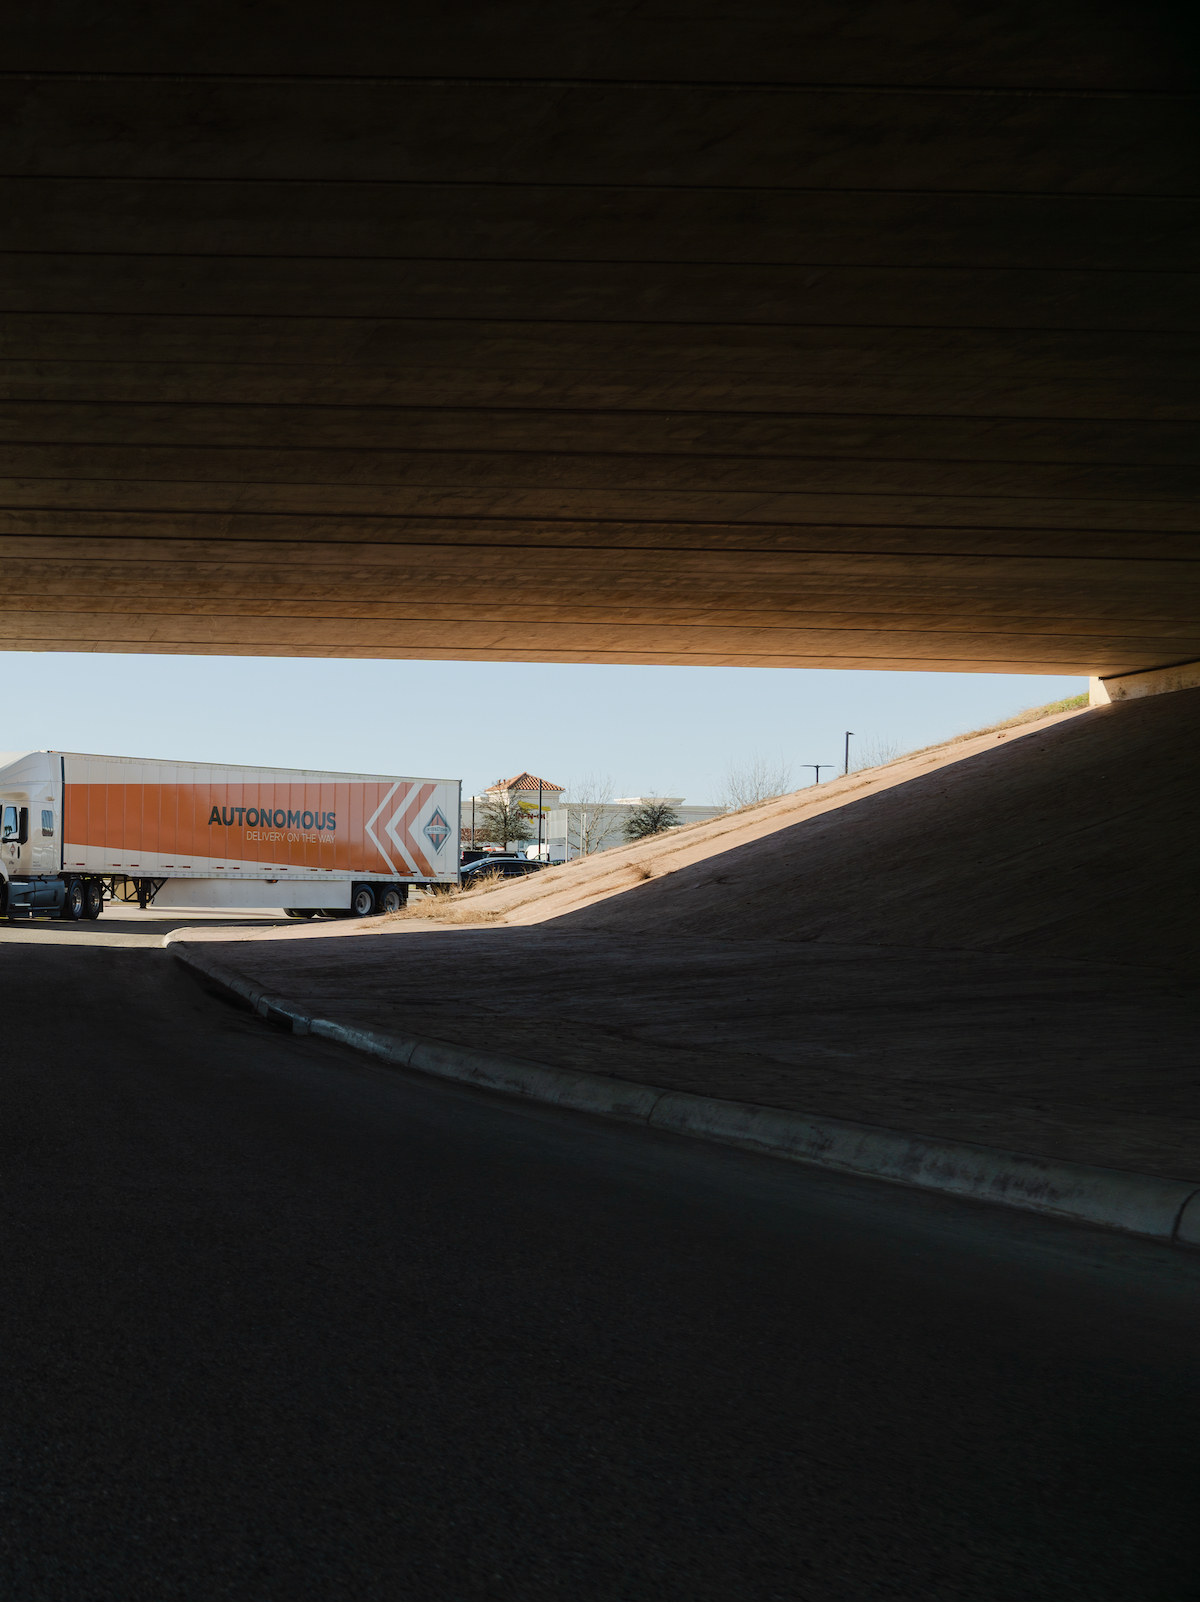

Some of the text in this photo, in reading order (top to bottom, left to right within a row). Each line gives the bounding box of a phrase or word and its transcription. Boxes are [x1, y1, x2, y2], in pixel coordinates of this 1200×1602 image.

[208, 806, 336, 831] AUTONOMOUS
[247, 831, 336, 843] DELIVERY ON THE WAY
